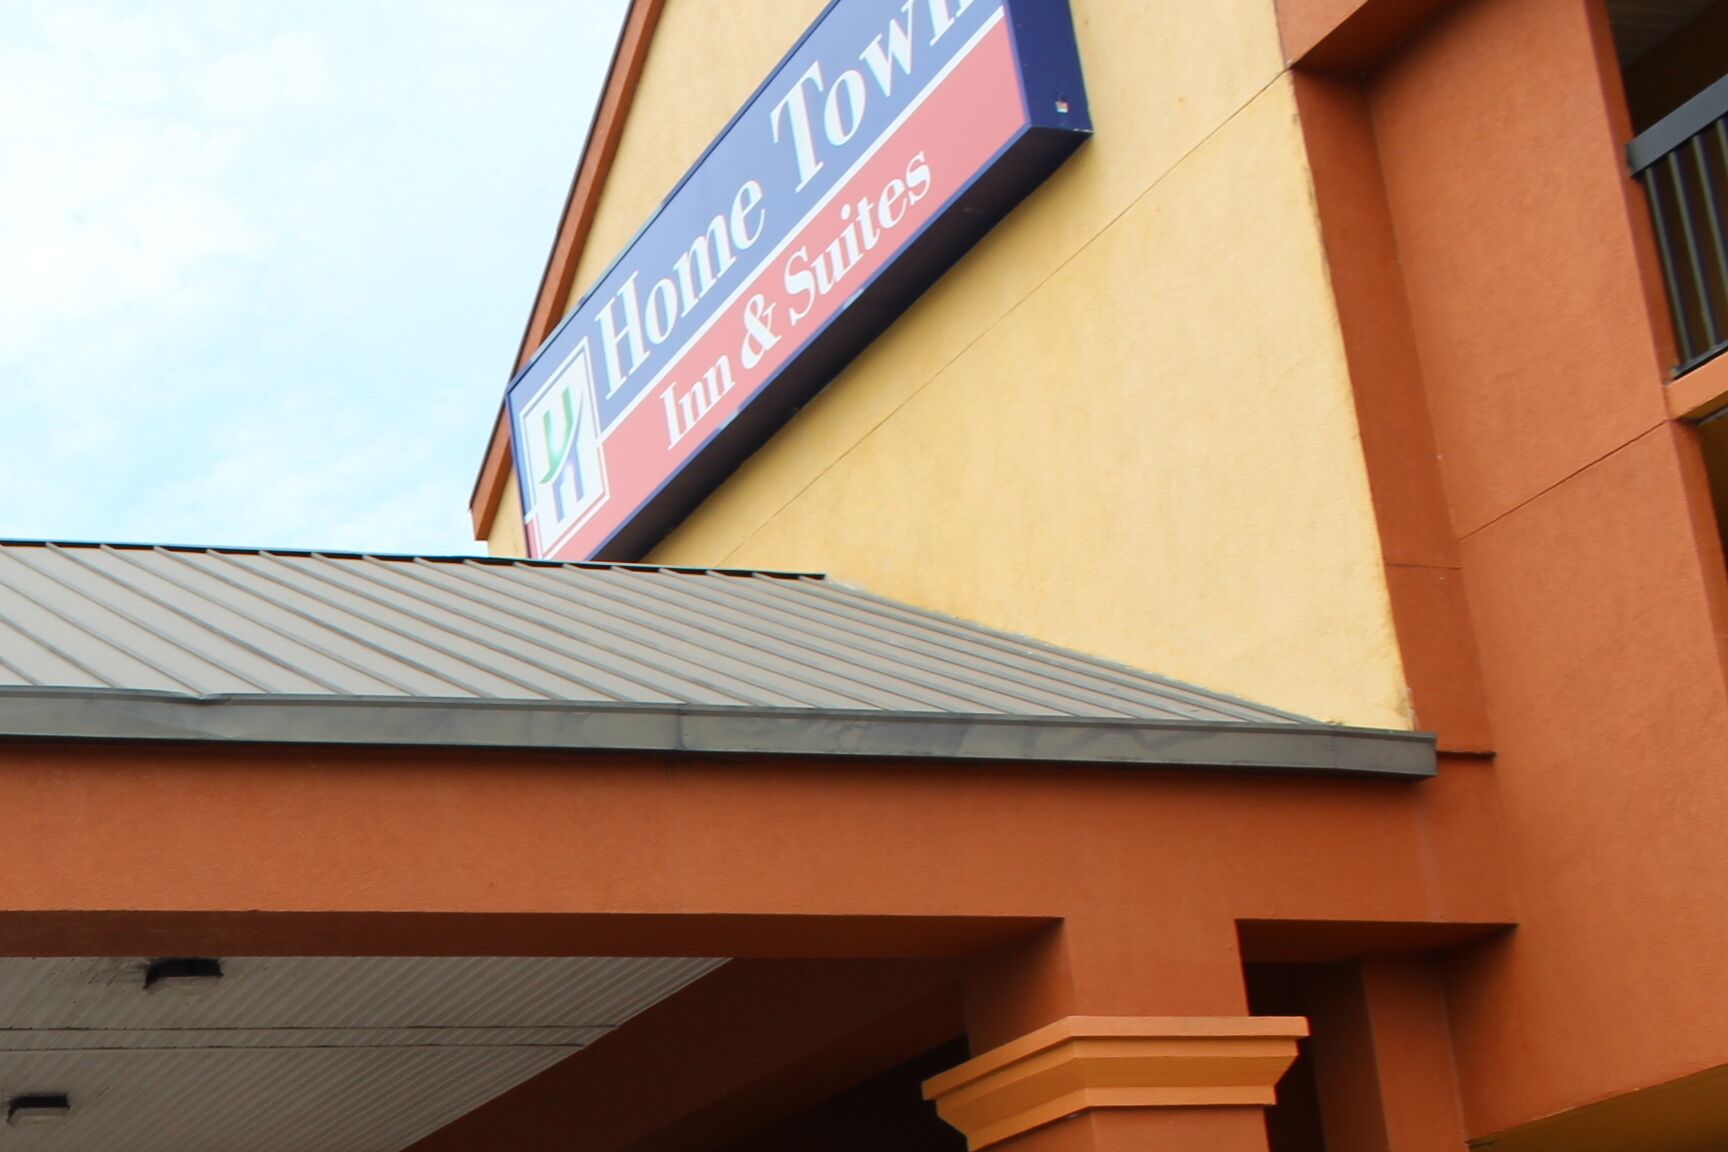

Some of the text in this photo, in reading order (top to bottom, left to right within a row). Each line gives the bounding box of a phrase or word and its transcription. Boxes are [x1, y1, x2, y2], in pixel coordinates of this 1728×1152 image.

[594, 180, 766, 400] Home
[660, 151, 931, 450] Inn & Suites
